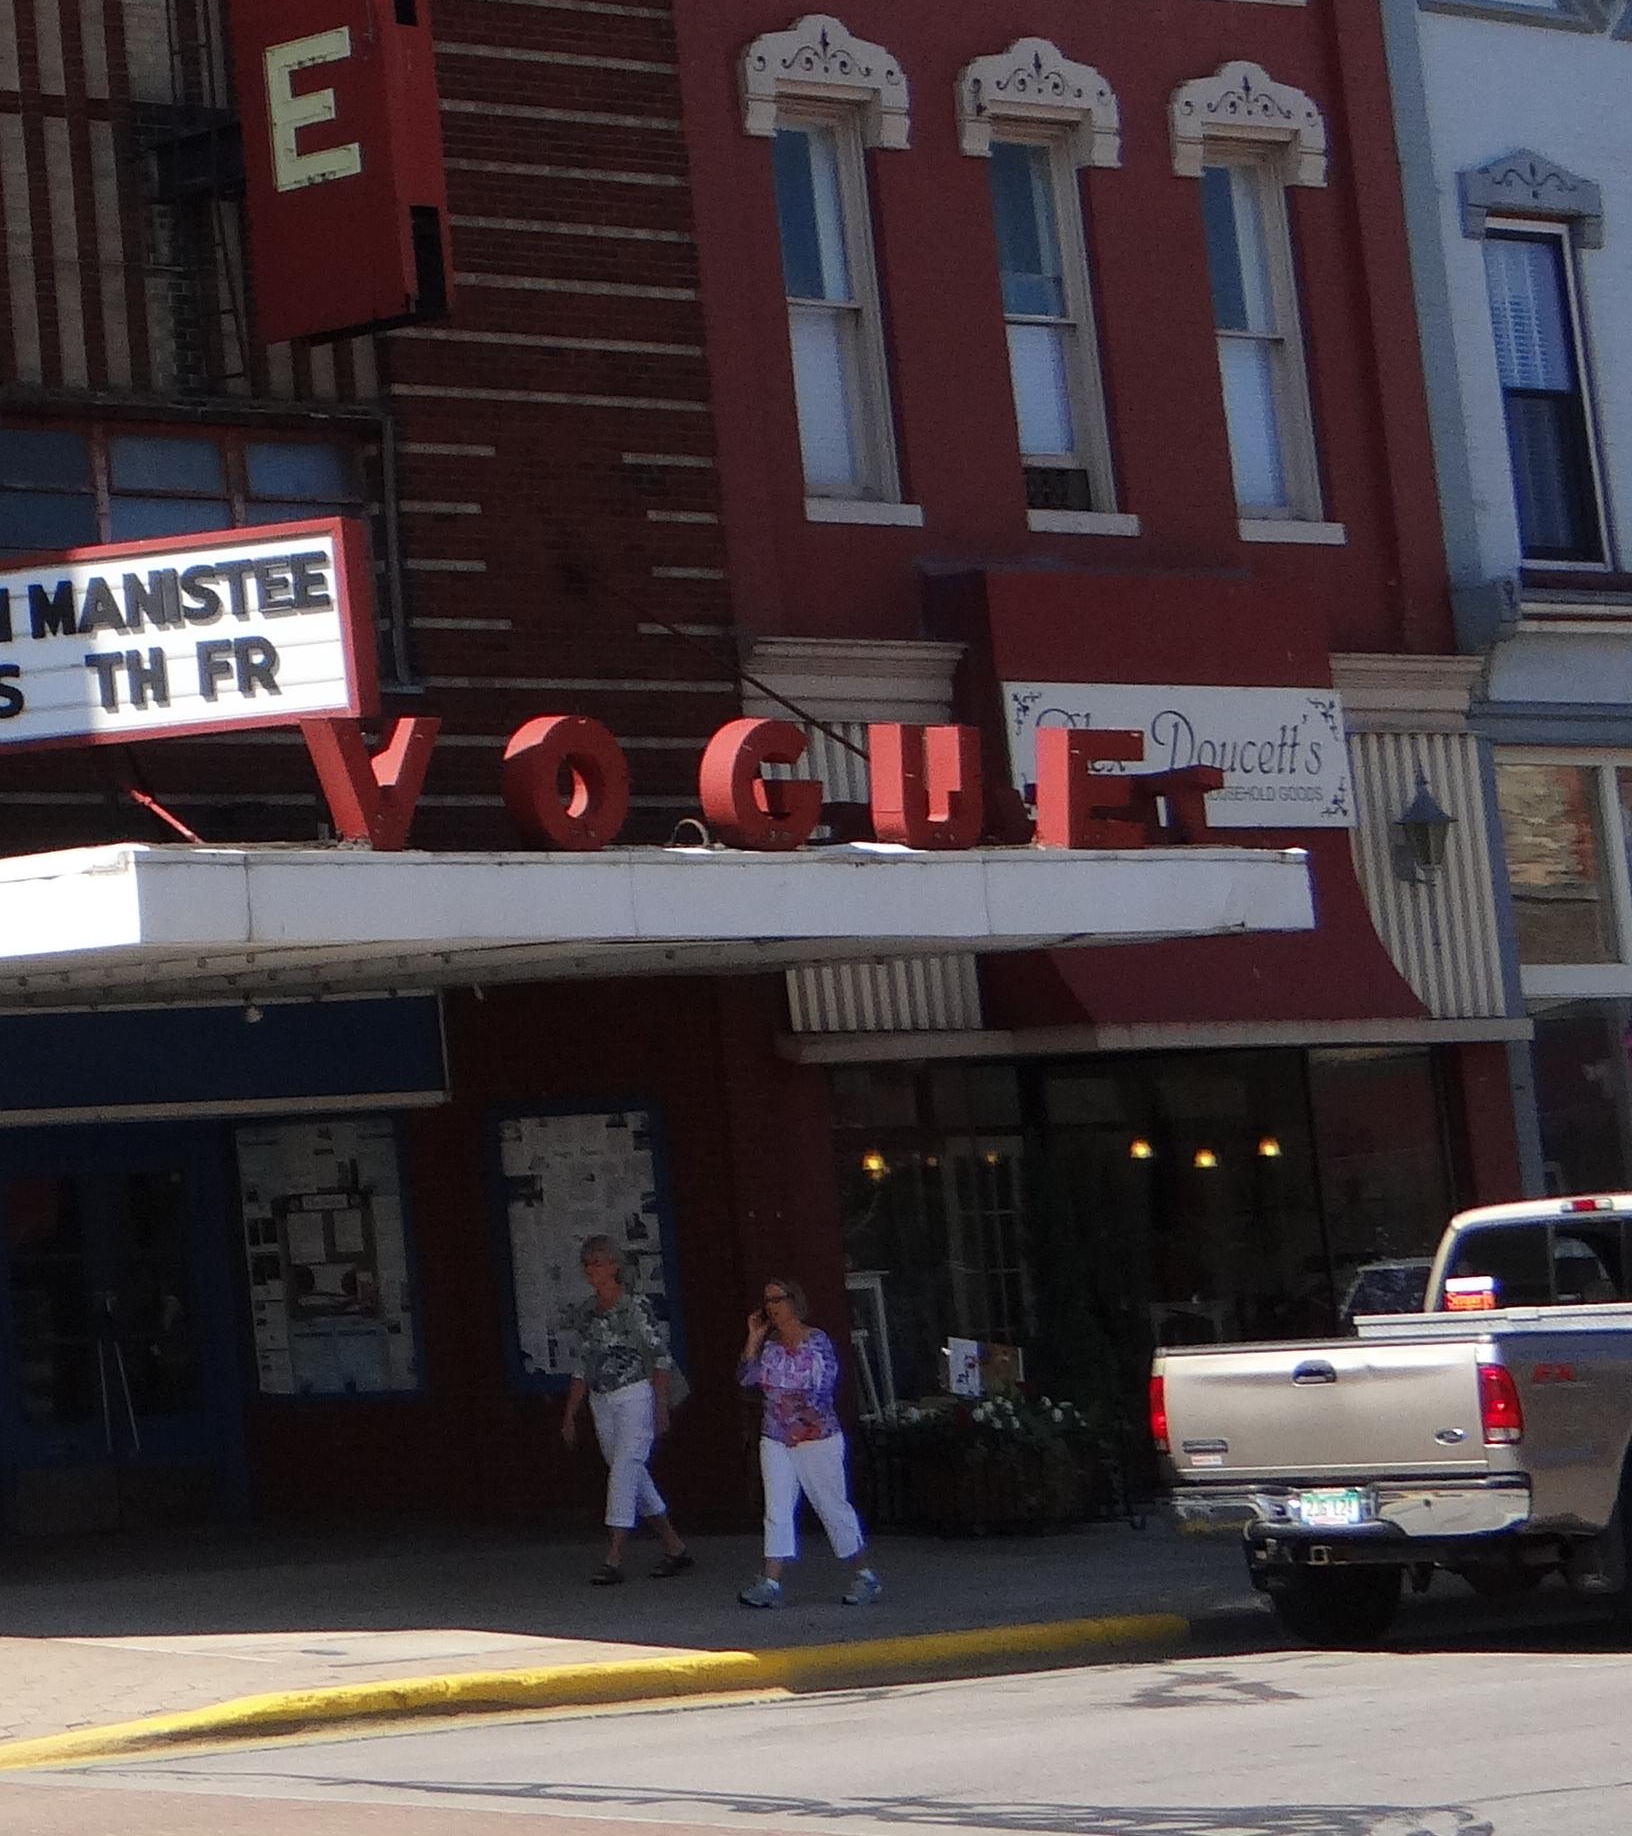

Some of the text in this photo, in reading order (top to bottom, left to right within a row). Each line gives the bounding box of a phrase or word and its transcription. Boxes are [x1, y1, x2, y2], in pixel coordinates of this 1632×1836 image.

[28, 549, 333, 641] MANISTEE
[84, 646, 172, 714] TH
[196, 634, 284, 704] FR
[1150, 709, 1325, 776] Doucett's
[300, 714, 1144, 852] VOGUE
[1206, 785, 1276, 802] OUSEHOLD
